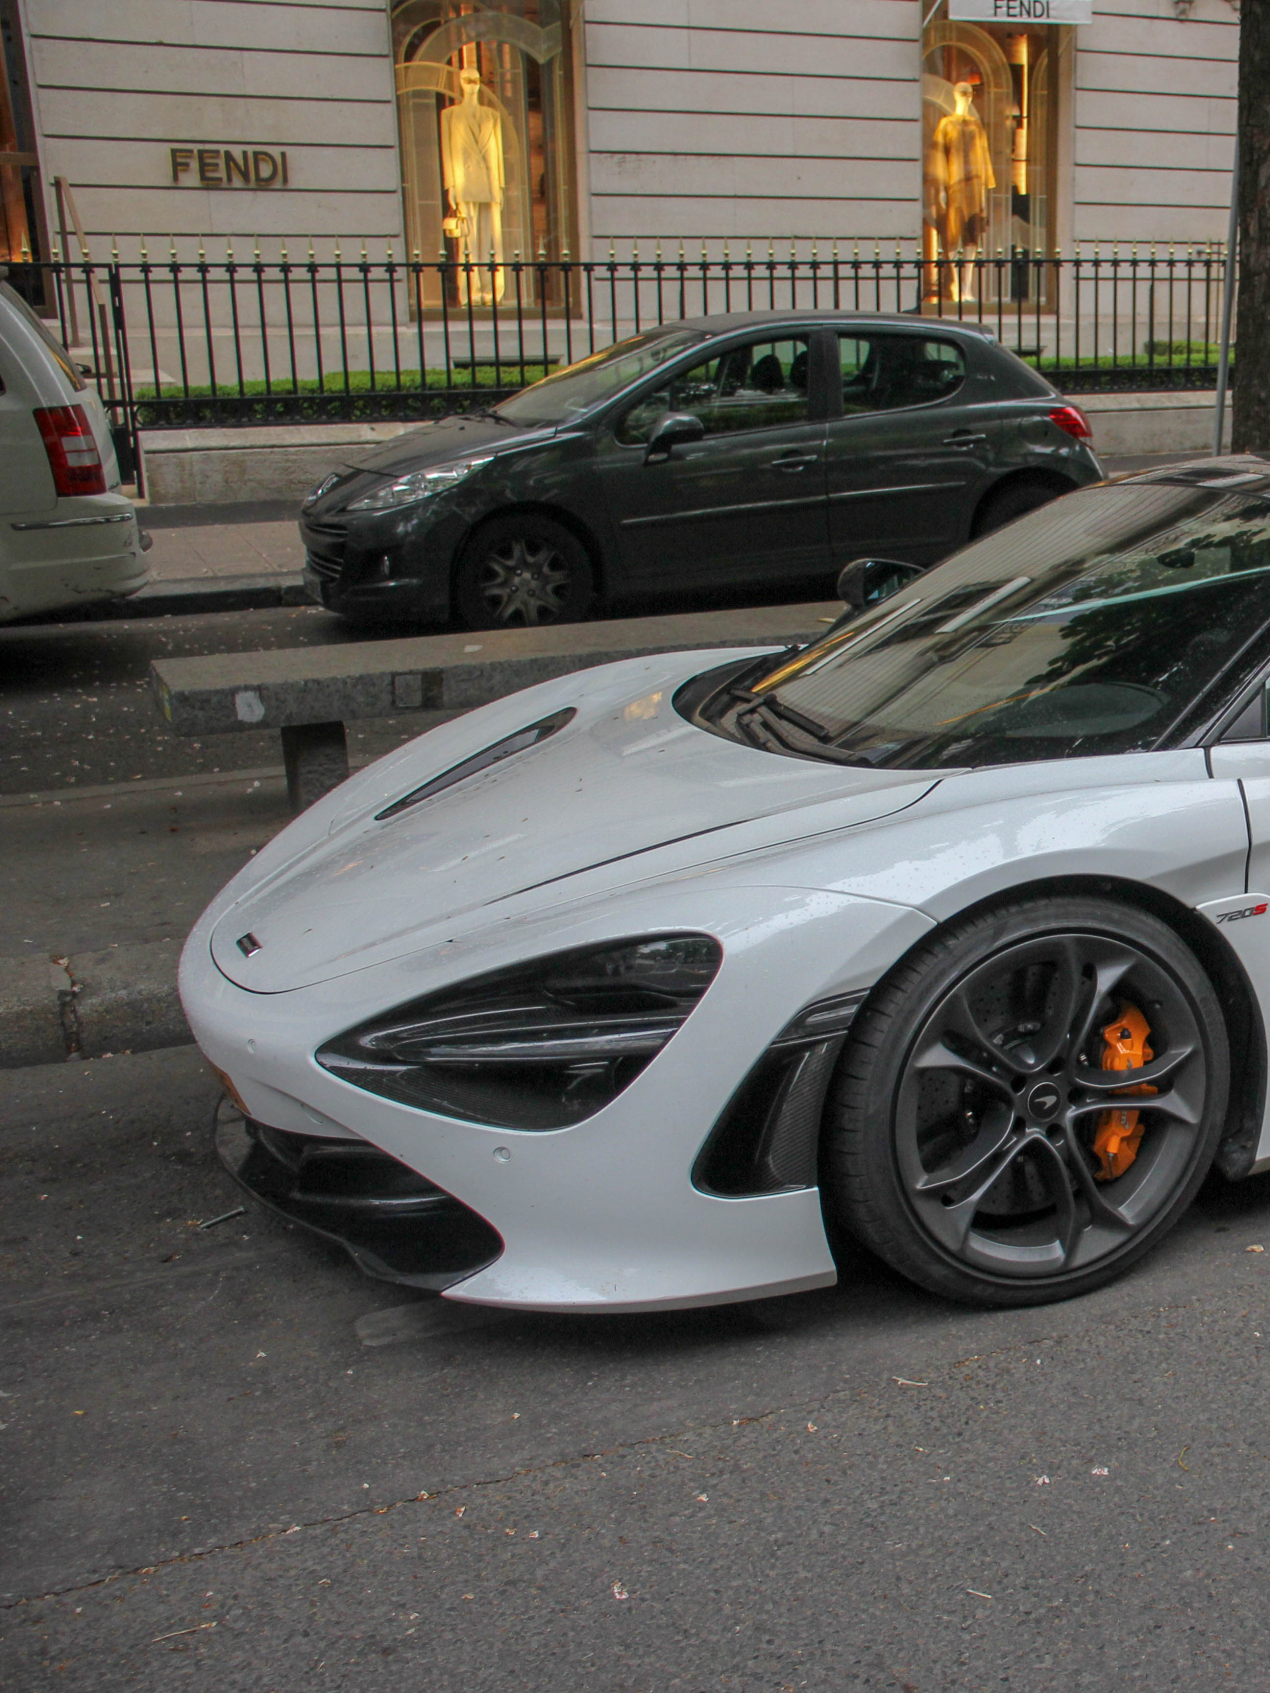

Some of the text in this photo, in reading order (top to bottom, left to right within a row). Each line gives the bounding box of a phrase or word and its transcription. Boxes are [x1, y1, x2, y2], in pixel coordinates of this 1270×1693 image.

[993, 0, 1050, 18] FENDI
[170, 148, 289, 186] FENDI
[1216, 903, 1269, 925] 720S
